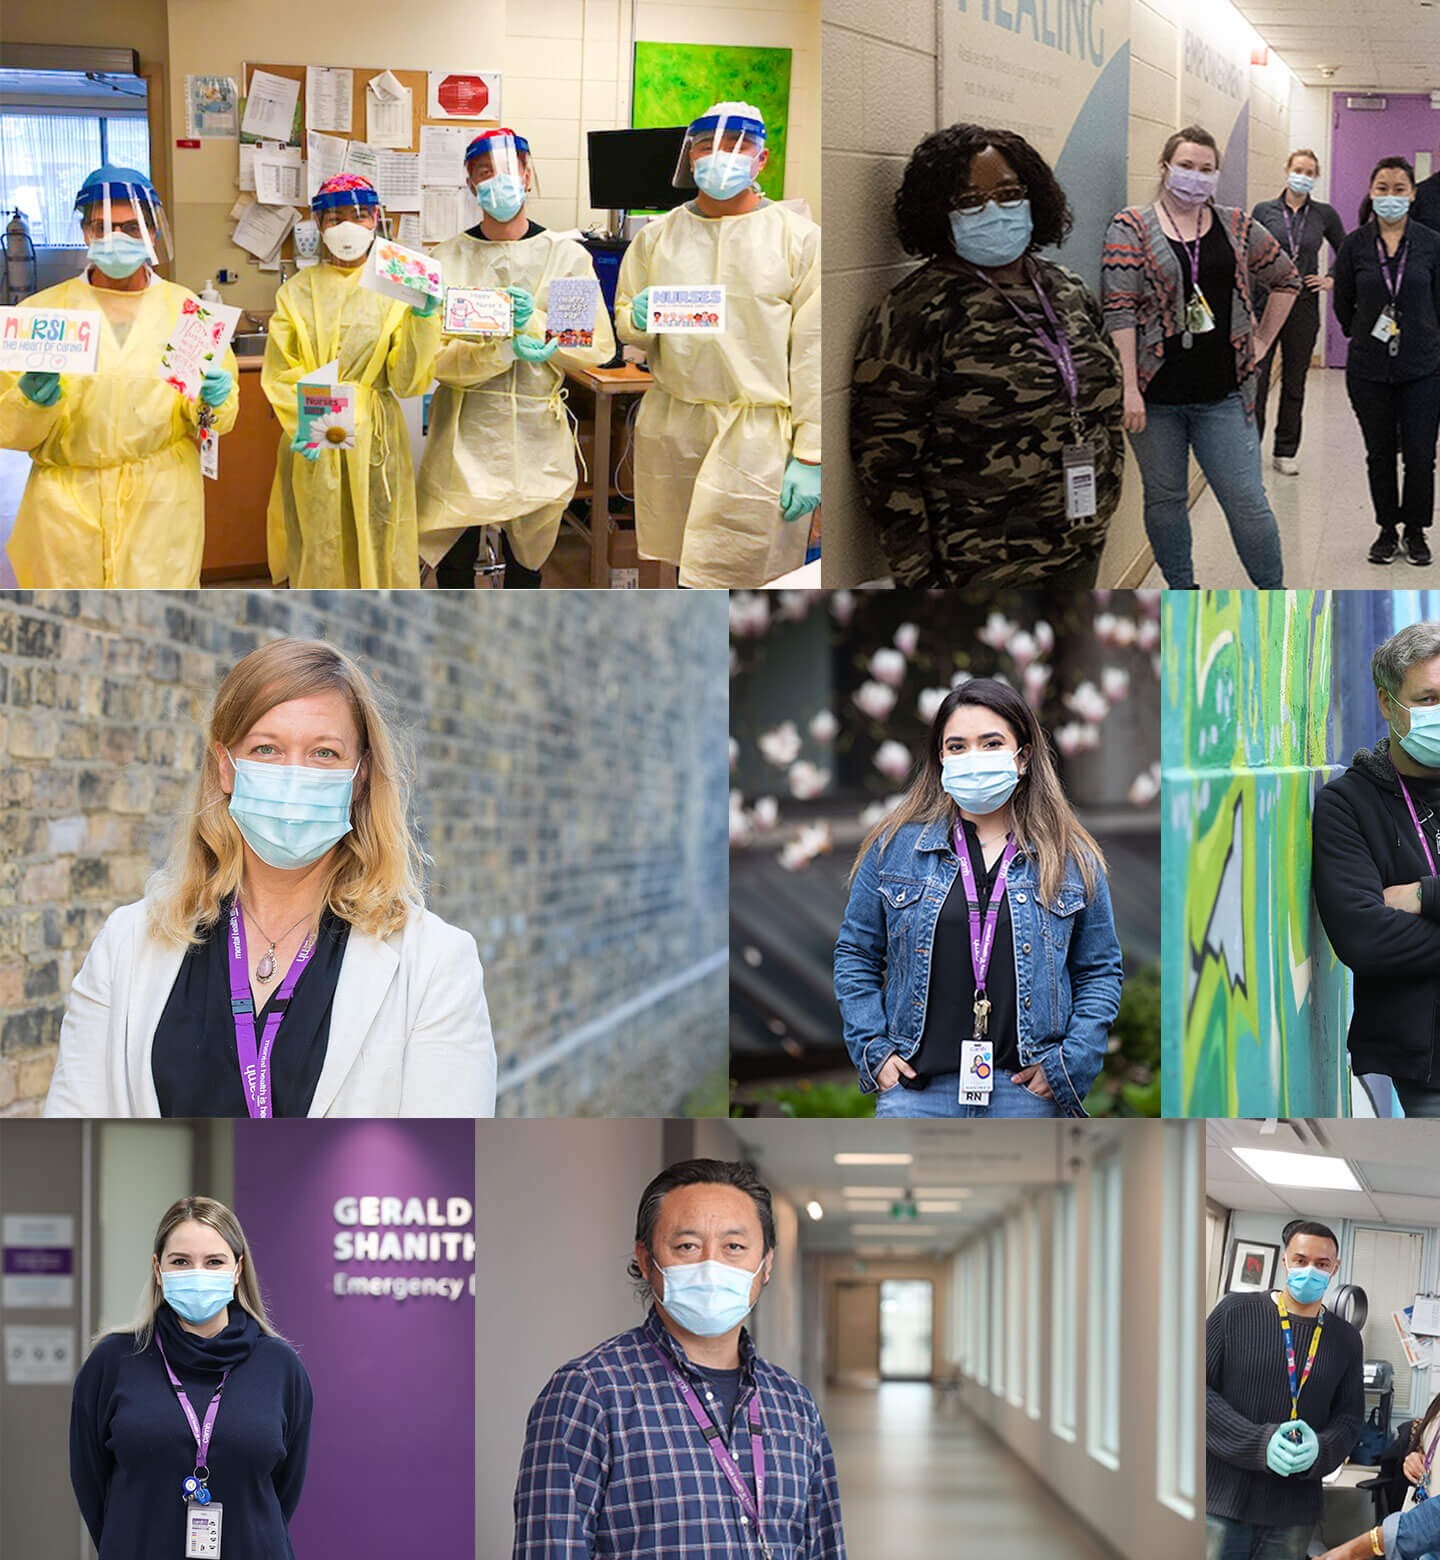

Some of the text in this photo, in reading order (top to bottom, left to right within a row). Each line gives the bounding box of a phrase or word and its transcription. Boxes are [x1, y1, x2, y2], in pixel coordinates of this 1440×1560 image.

[653, 291, 721, 304] NURSES
[966, 1092, 982, 1101] RN
[333, 1196, 473, 1226] GERALD
[333, 1272, 464, 1301] Emergency
